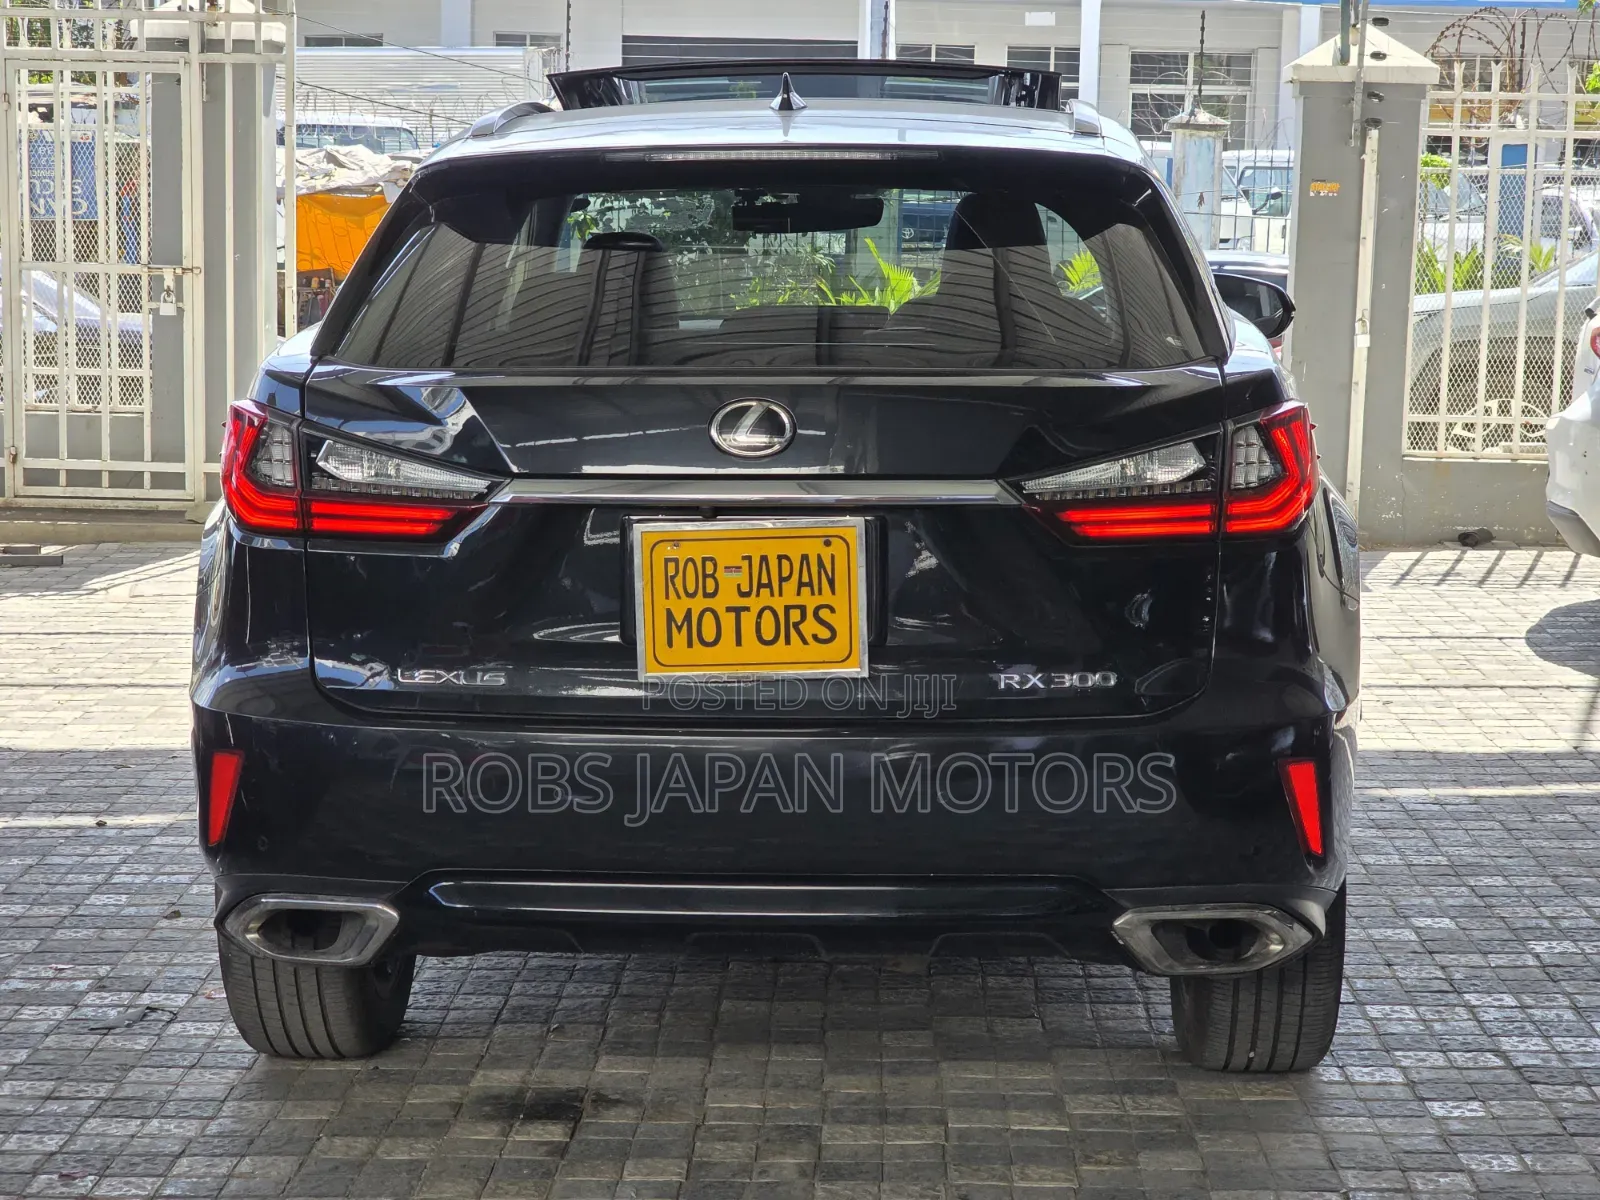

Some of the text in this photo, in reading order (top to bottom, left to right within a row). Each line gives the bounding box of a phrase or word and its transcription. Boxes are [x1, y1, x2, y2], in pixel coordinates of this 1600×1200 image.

[663, 553, 836, 600] ROB JAPAN
[665, 603, 837, 649] MOTORS
[397, 668, 506, 686] LEXUS
[998, 671, 1118, 689] RX 300
